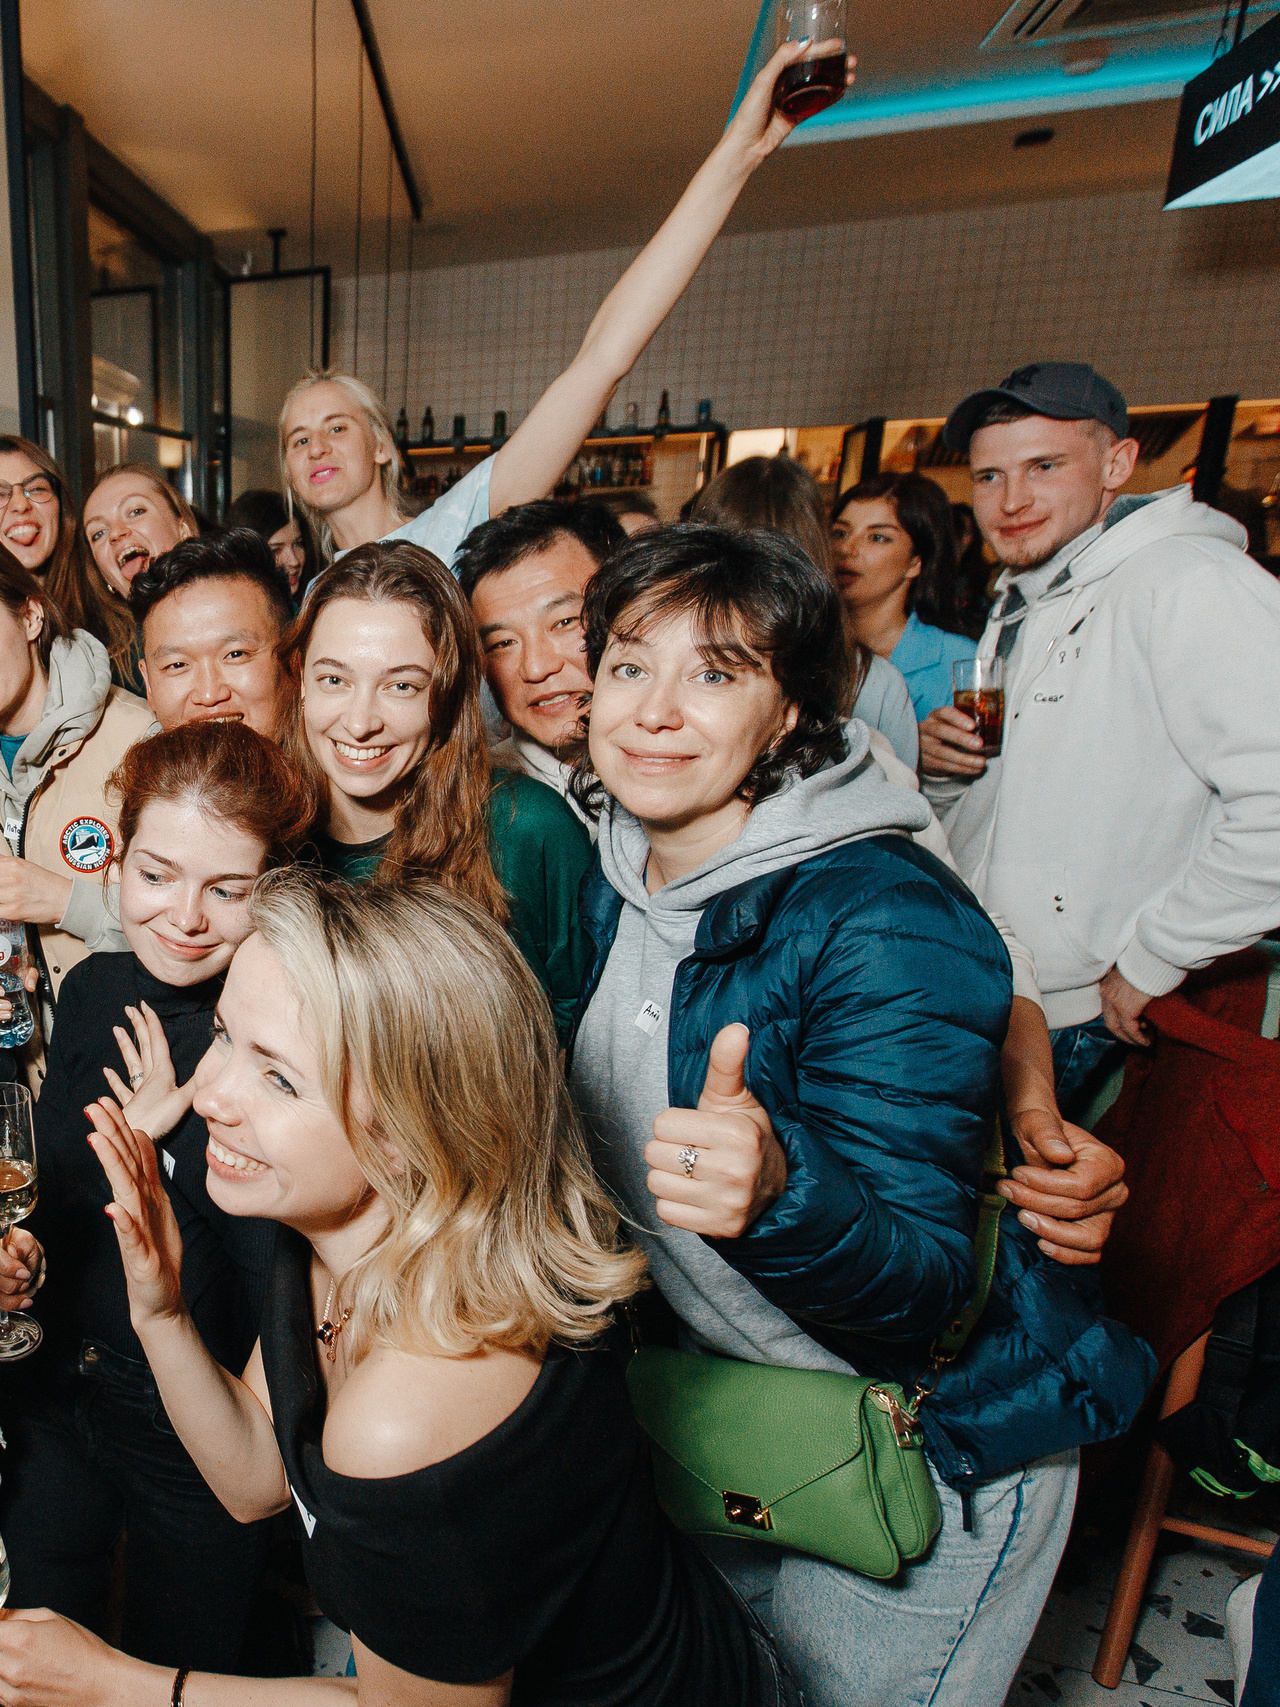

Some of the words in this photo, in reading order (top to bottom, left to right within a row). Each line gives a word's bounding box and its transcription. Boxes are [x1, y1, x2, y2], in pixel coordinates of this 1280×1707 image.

[1194, 73, 1254, 147] СИЛА
[62, 822, 79, 845] ARCTIC
[79, 819, 110, 840] EXPLORER
[65, 853, 93, 870] RUSSIAN
[93, 848, 111, 868] NORTH
